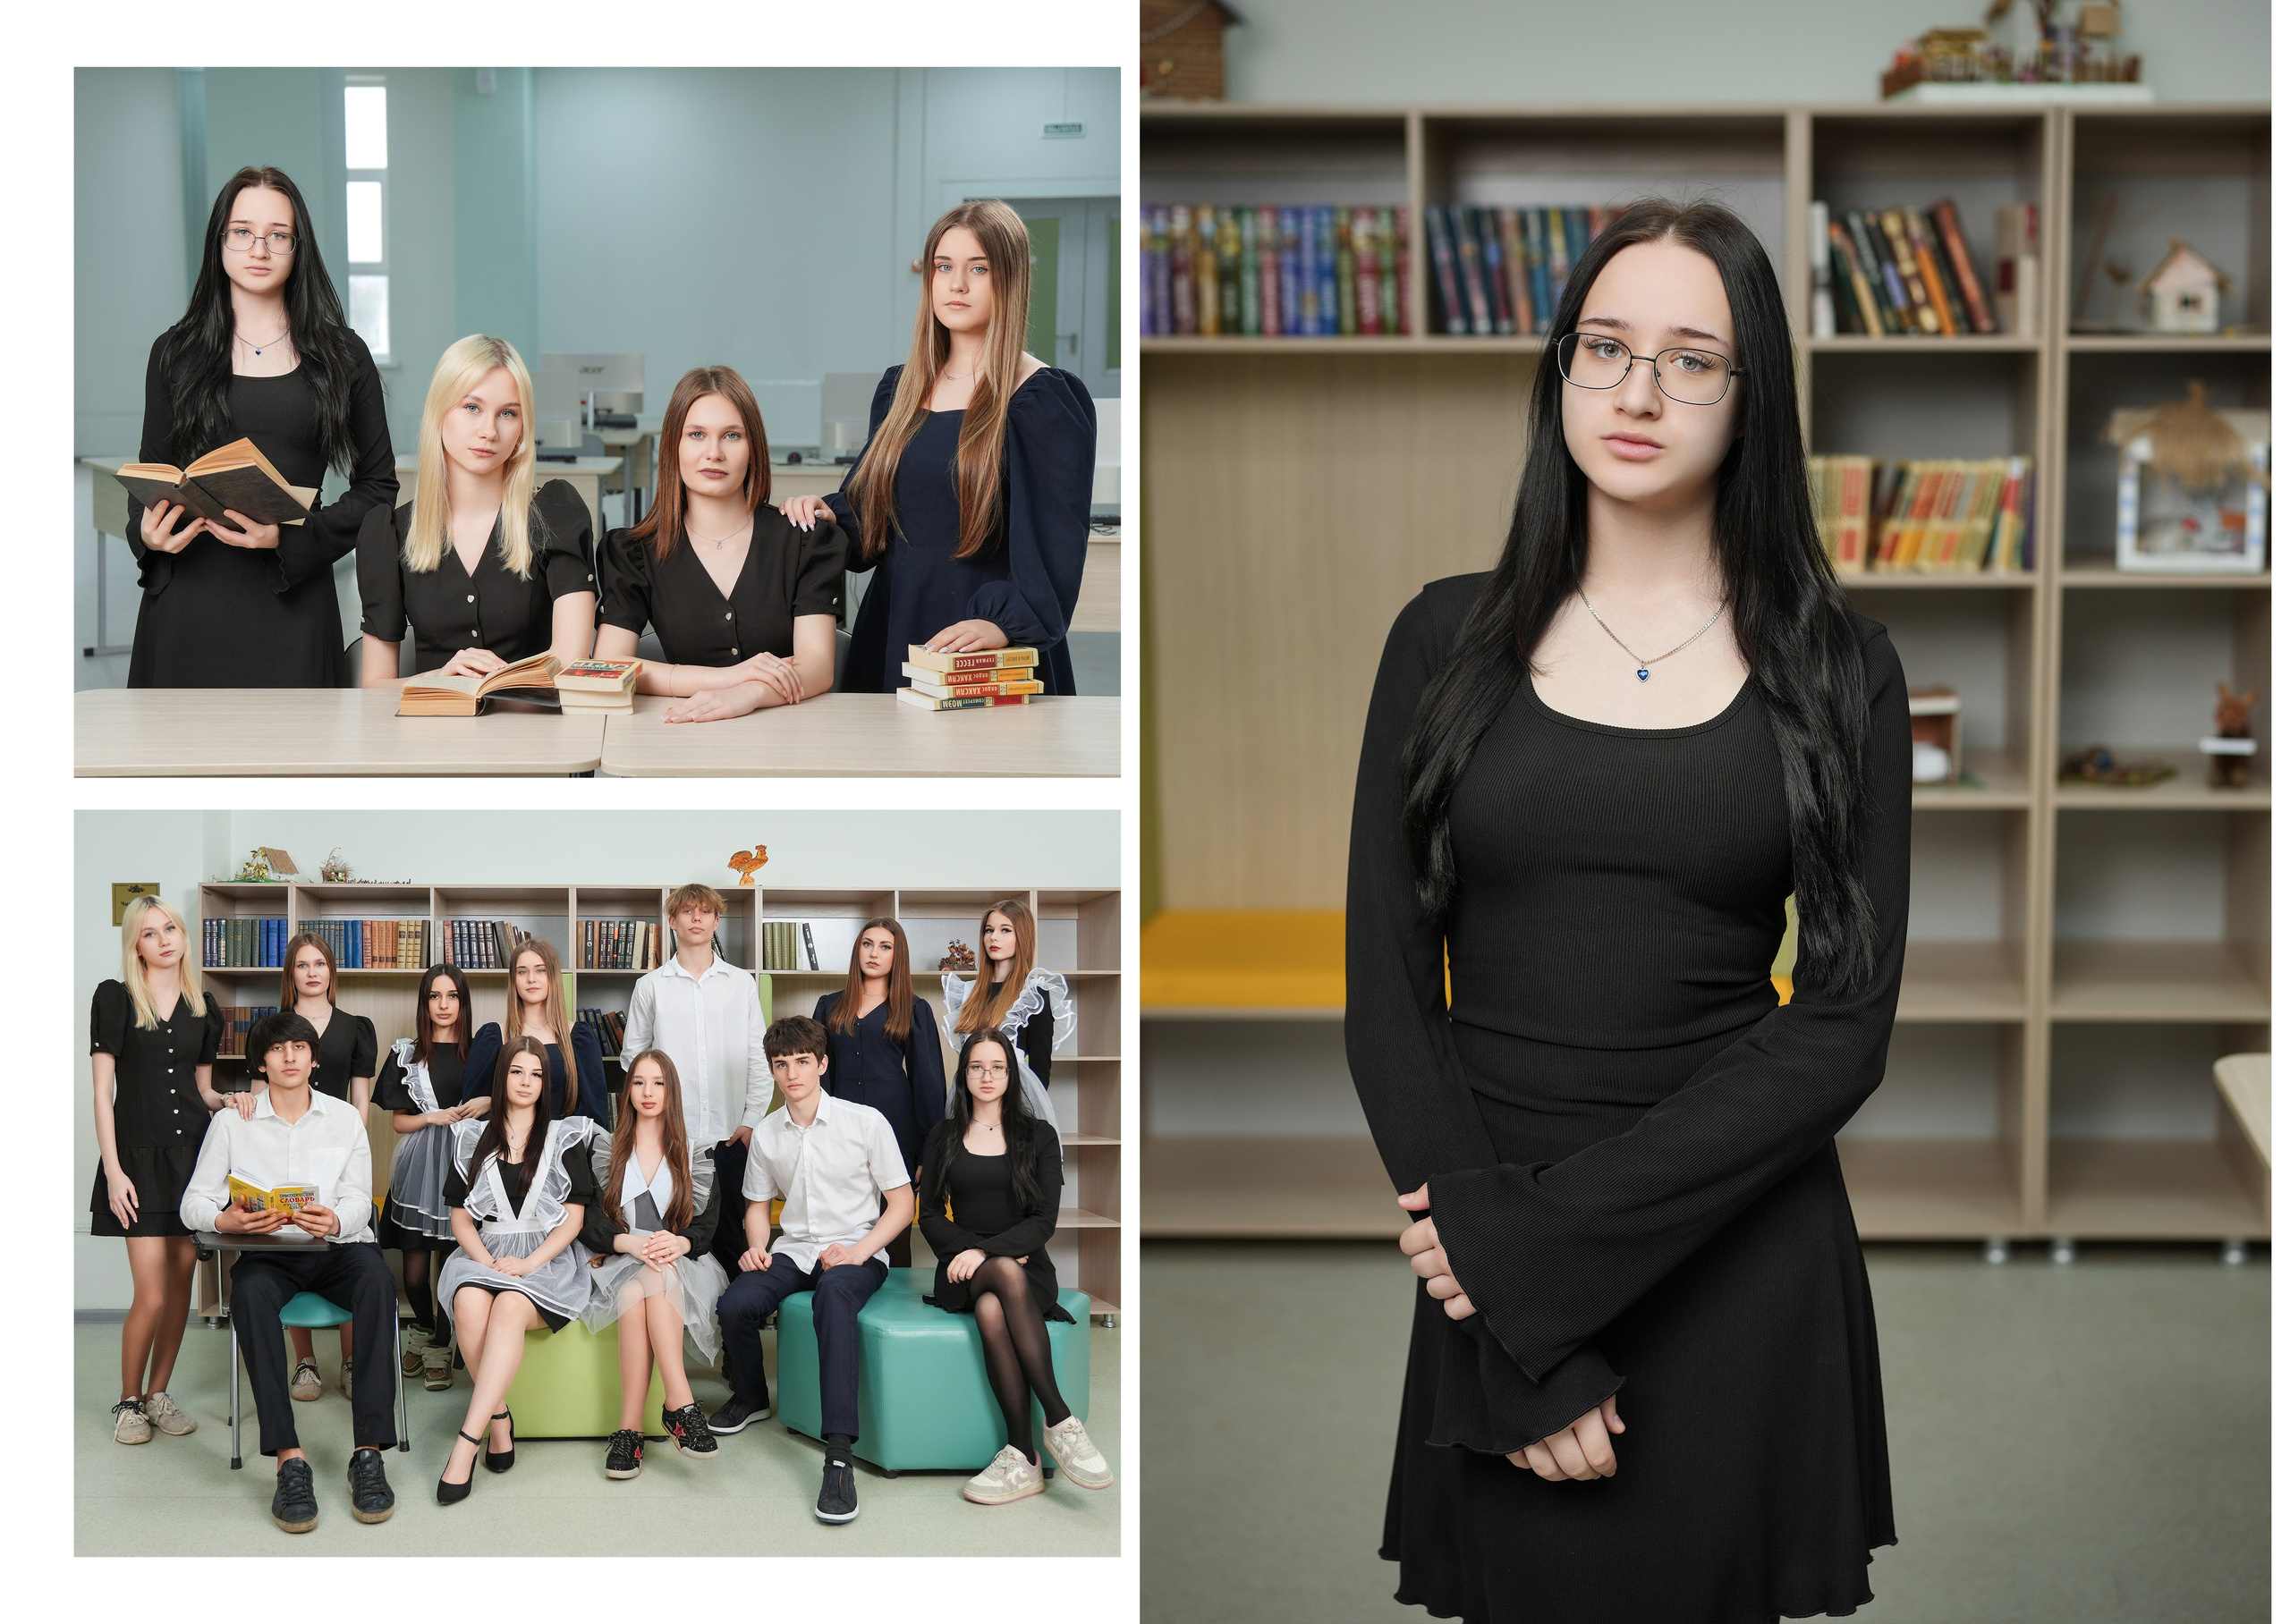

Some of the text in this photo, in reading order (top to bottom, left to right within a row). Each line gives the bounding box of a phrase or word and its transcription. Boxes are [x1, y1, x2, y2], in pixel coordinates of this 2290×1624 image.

[956, 659, 975, 668] ГЕССЕ
[948, 674, 972, 683] ХАКСЛИ
[955, 687, 981, 696] ХАКСЛИ
[942, 699, 963, 708] МОЭМ
